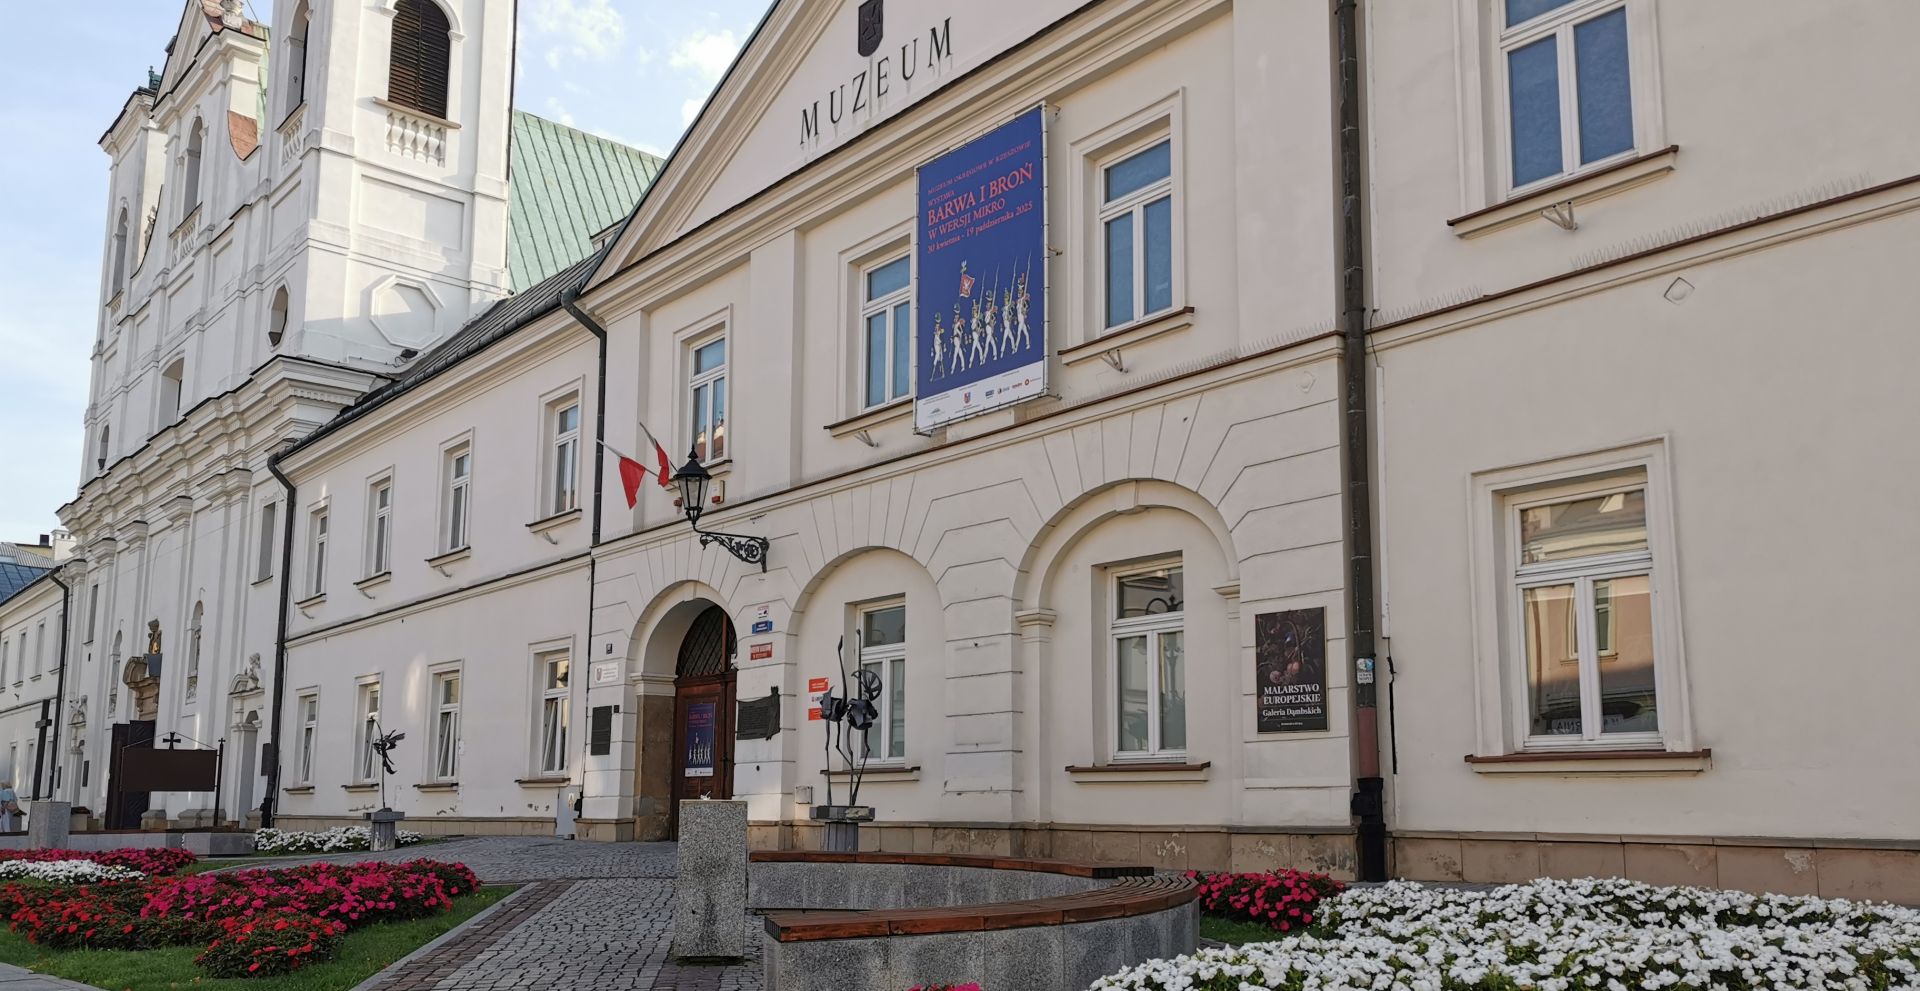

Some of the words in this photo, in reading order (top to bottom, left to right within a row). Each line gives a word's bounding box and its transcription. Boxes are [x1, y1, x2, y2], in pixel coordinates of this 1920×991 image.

[800, 16, 952, 145] MUZEUM
[928, 191, 976, 226] BARWA
[980, 184, 986, 203] I
[989, 162, 1033, 199] BROŃ
[928, 190, 955, 206] WYSTAWA
[928, 227, 938, 241] W
[939, 213, 971, 236] WERSJI
[973, 198, 1006, 220] MIKRO
[966, 227, 974, 238] 19
[1015, 200, 1033, 216] 2025
[1263, 693, 1321, 705] EUROPEJSKIE
[1264, 683, 1320, 695] MALARSTWO
[1262, 708, 1286, 717] Galeria
[1286, 706, 1322, 717] Dąmbskich
